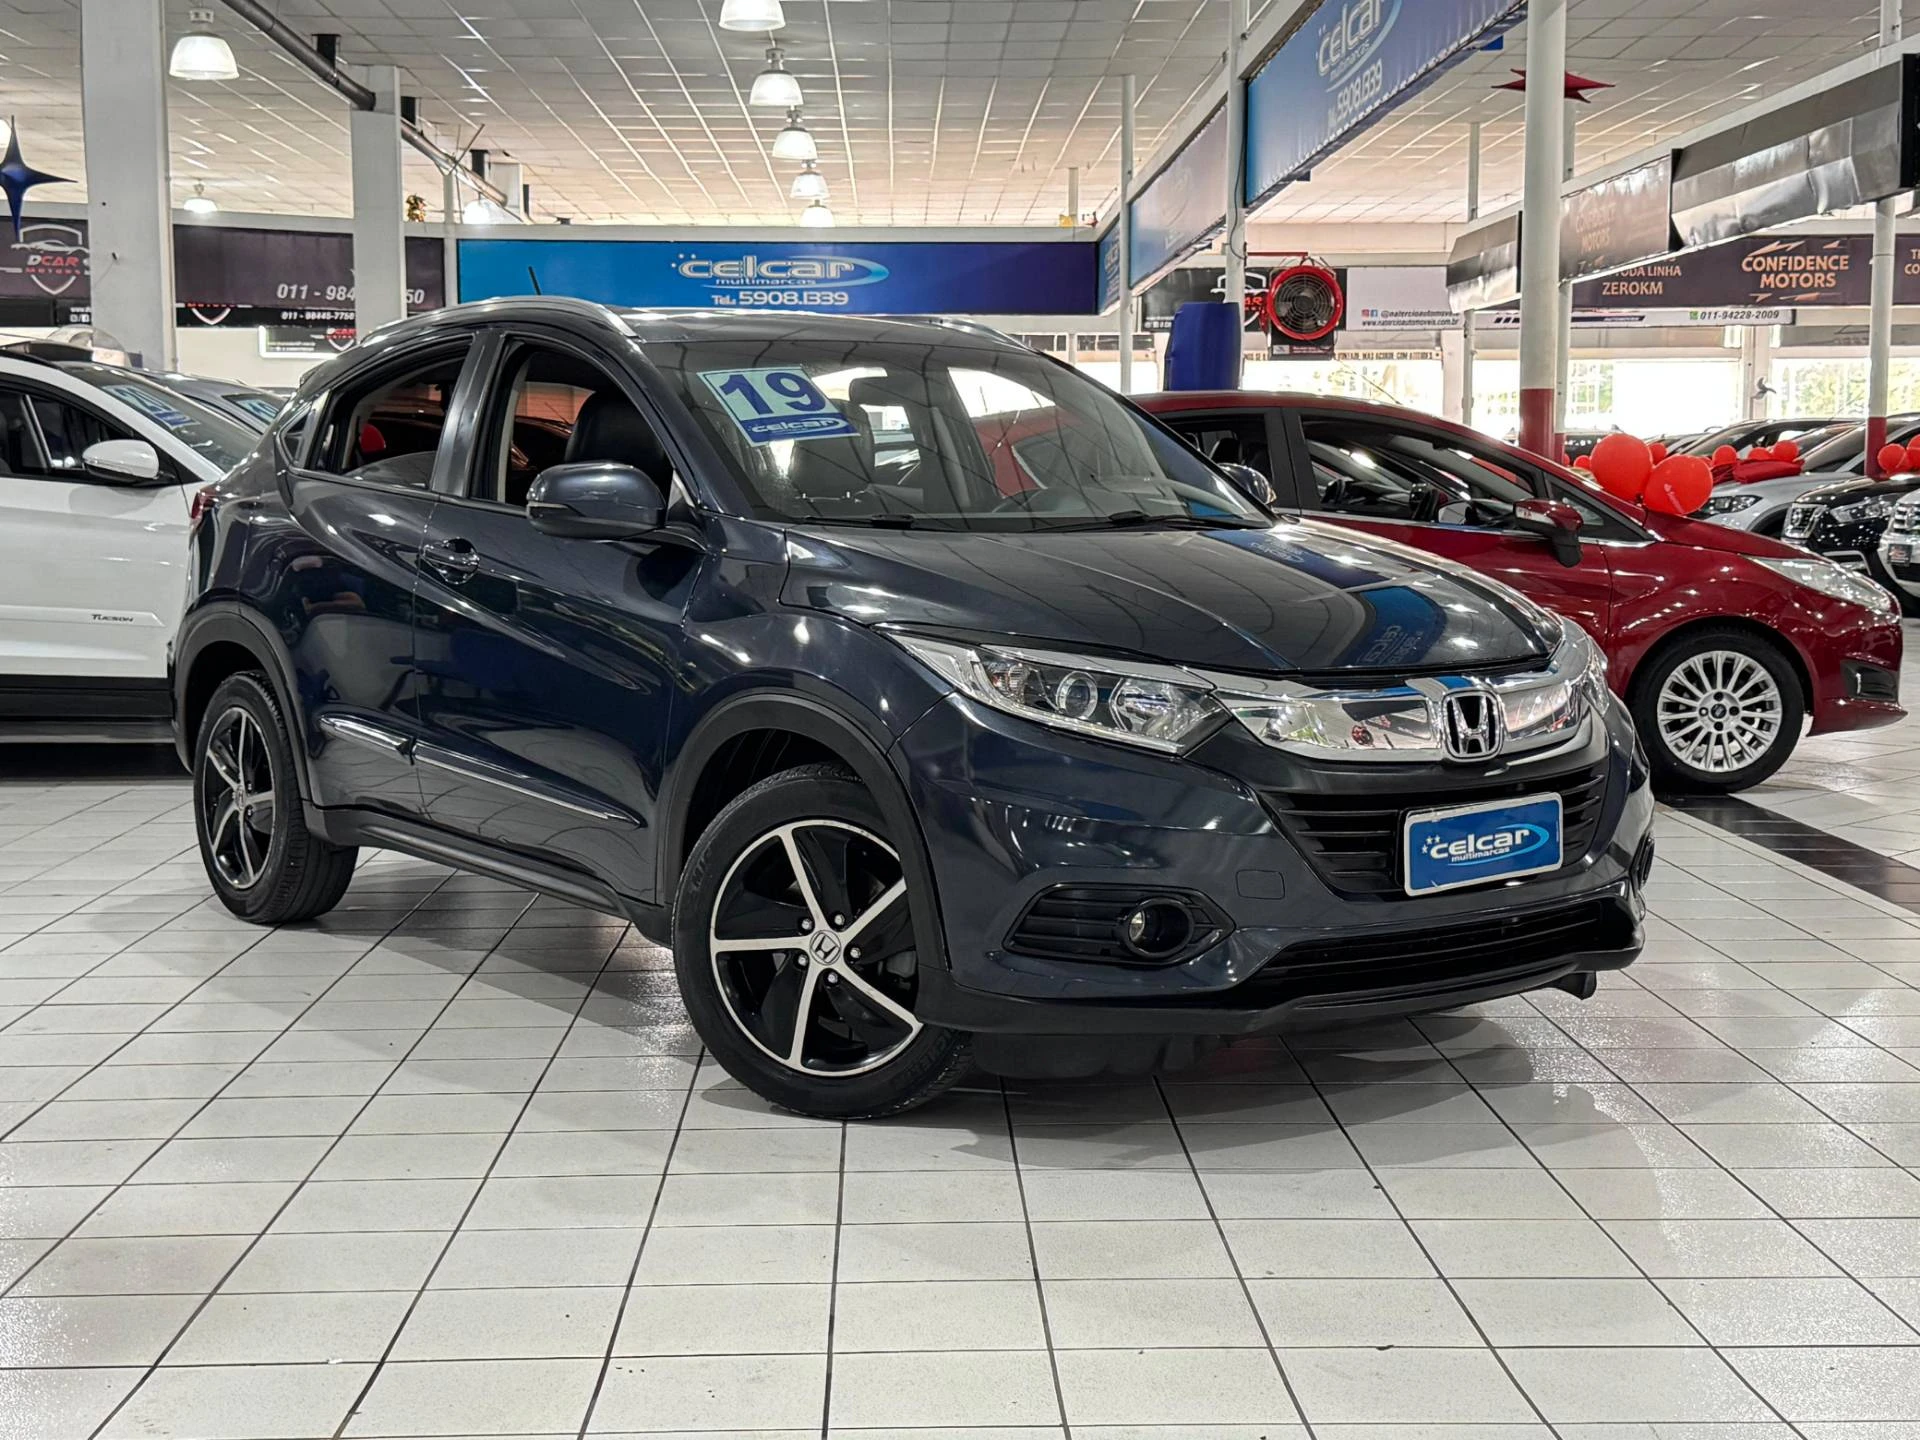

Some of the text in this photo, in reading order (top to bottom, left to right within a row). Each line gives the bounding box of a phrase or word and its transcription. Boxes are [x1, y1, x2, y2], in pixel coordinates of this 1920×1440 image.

[27, 255, 80, 267] DCAR
[679, 255, 855, 277] celcar
[1741, 255, 1849, 272] CONFIDENCE
[1647, 264, 1682, 277] LINHA
[716, 277, 816, 286] multimarcas
[1602, 281, 1663, 296] ZEROKM
[1759, 272, 1837, 289] MOTORS
[276, 283, 309, 300] 011
[1699, 309, 1779, 321] 011-94228-2009
[719, 372, 826, 416] 19
[751, 419, 835, 433] celcar
[1429, 828, 1530, 859] celcar
[1451, 846, 1511, 863] multimarcas
